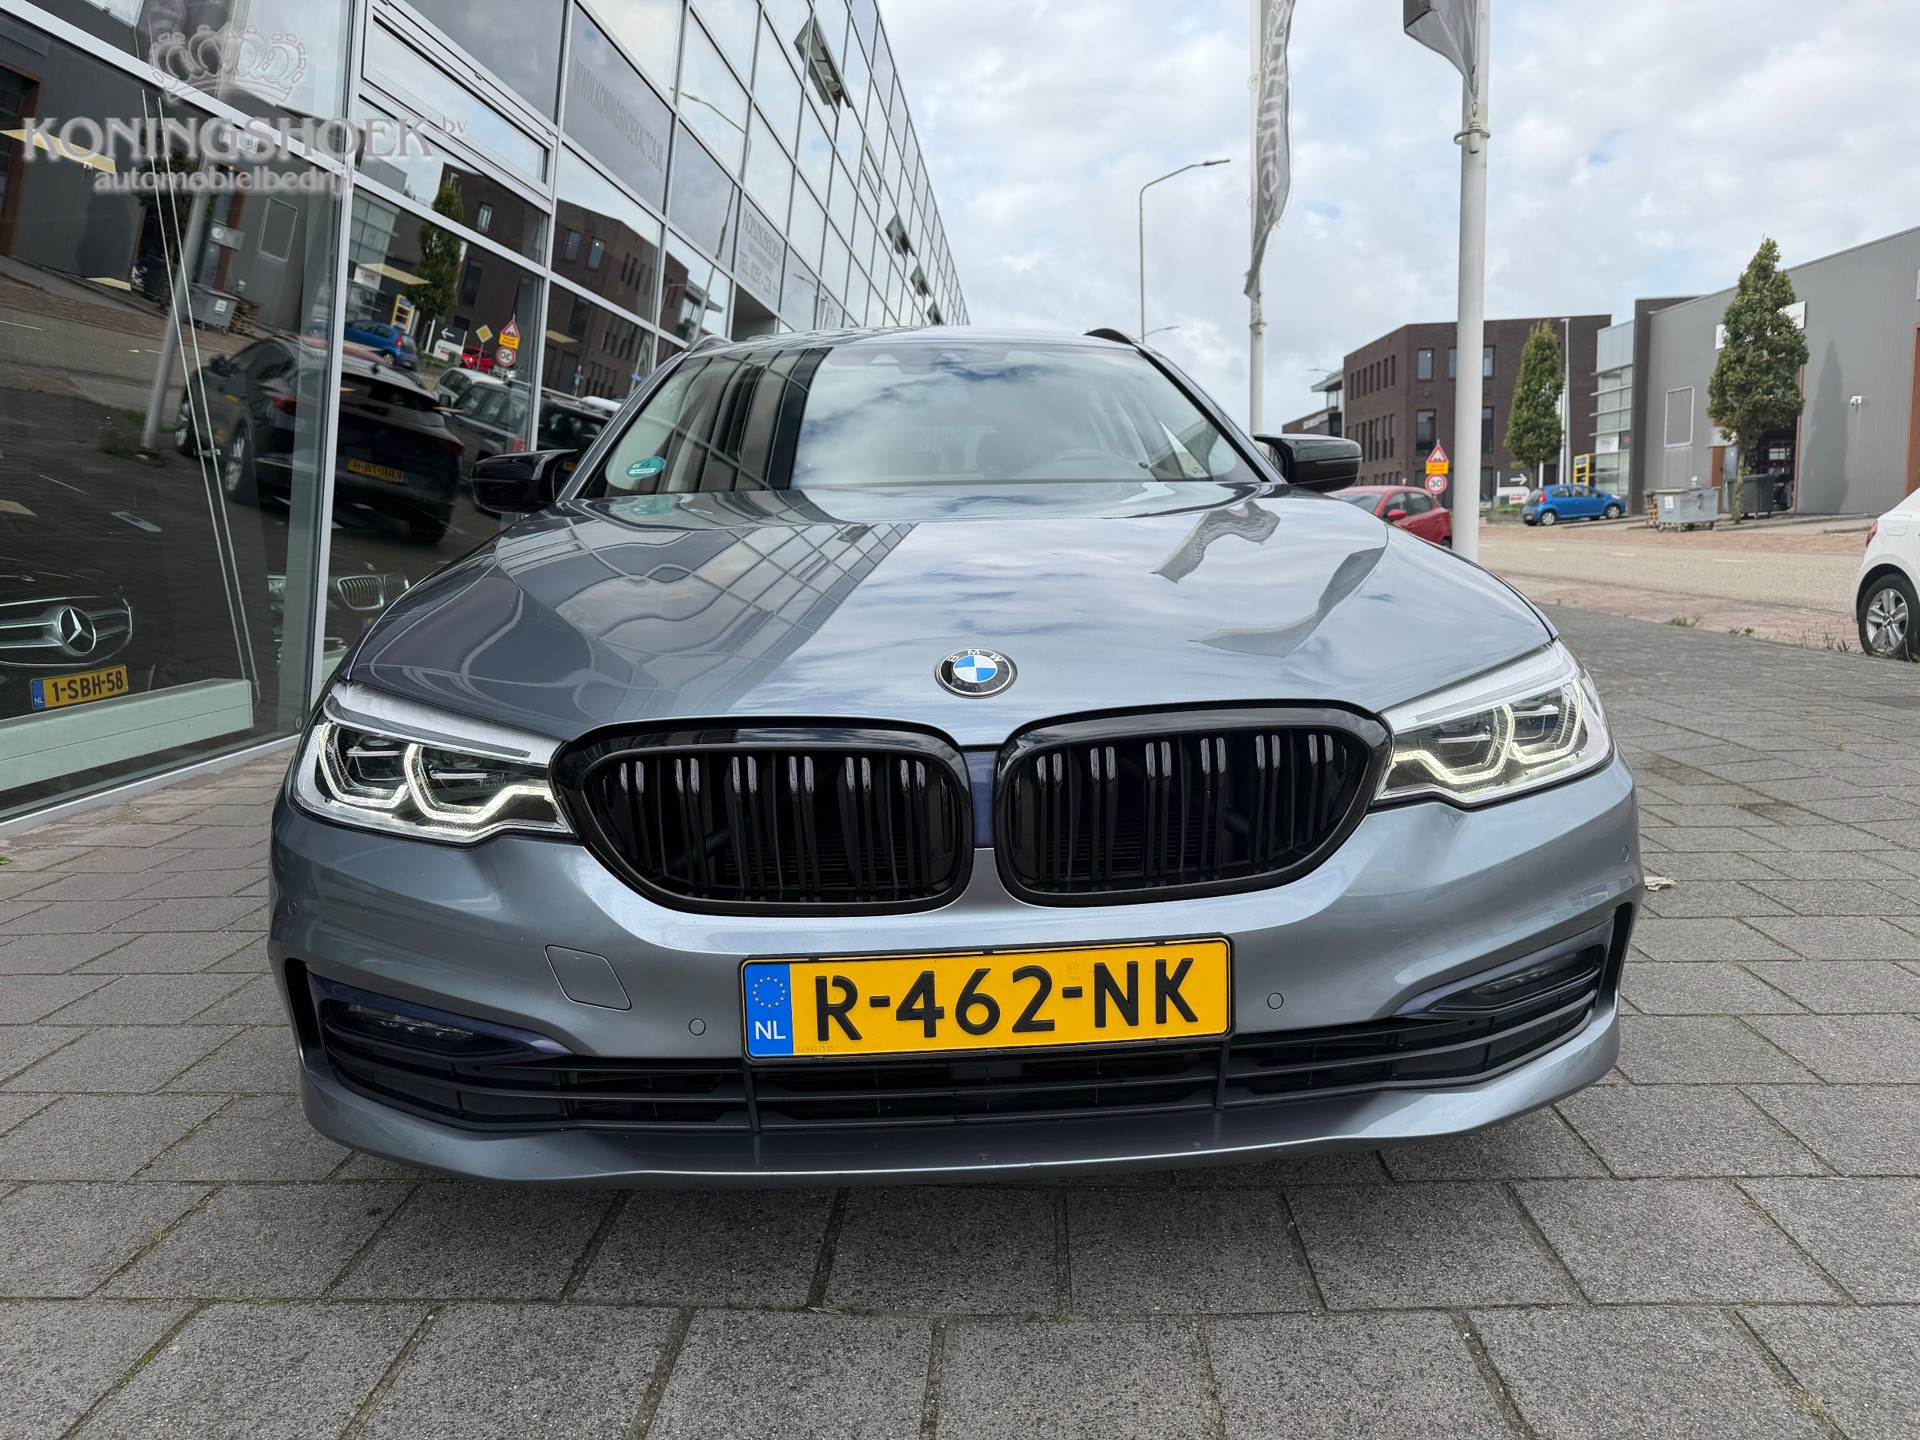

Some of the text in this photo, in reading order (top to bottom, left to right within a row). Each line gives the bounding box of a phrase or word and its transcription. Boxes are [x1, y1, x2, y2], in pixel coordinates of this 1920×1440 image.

[1430, 480, 1442, 488] 30
[947, 650, 1003, 662] BMW
[52, 670, 124, 702] 1-SBH-58
[816, 958, 1199, 1042] R-462-NK
[755, 1020, 786, 1041] NL
